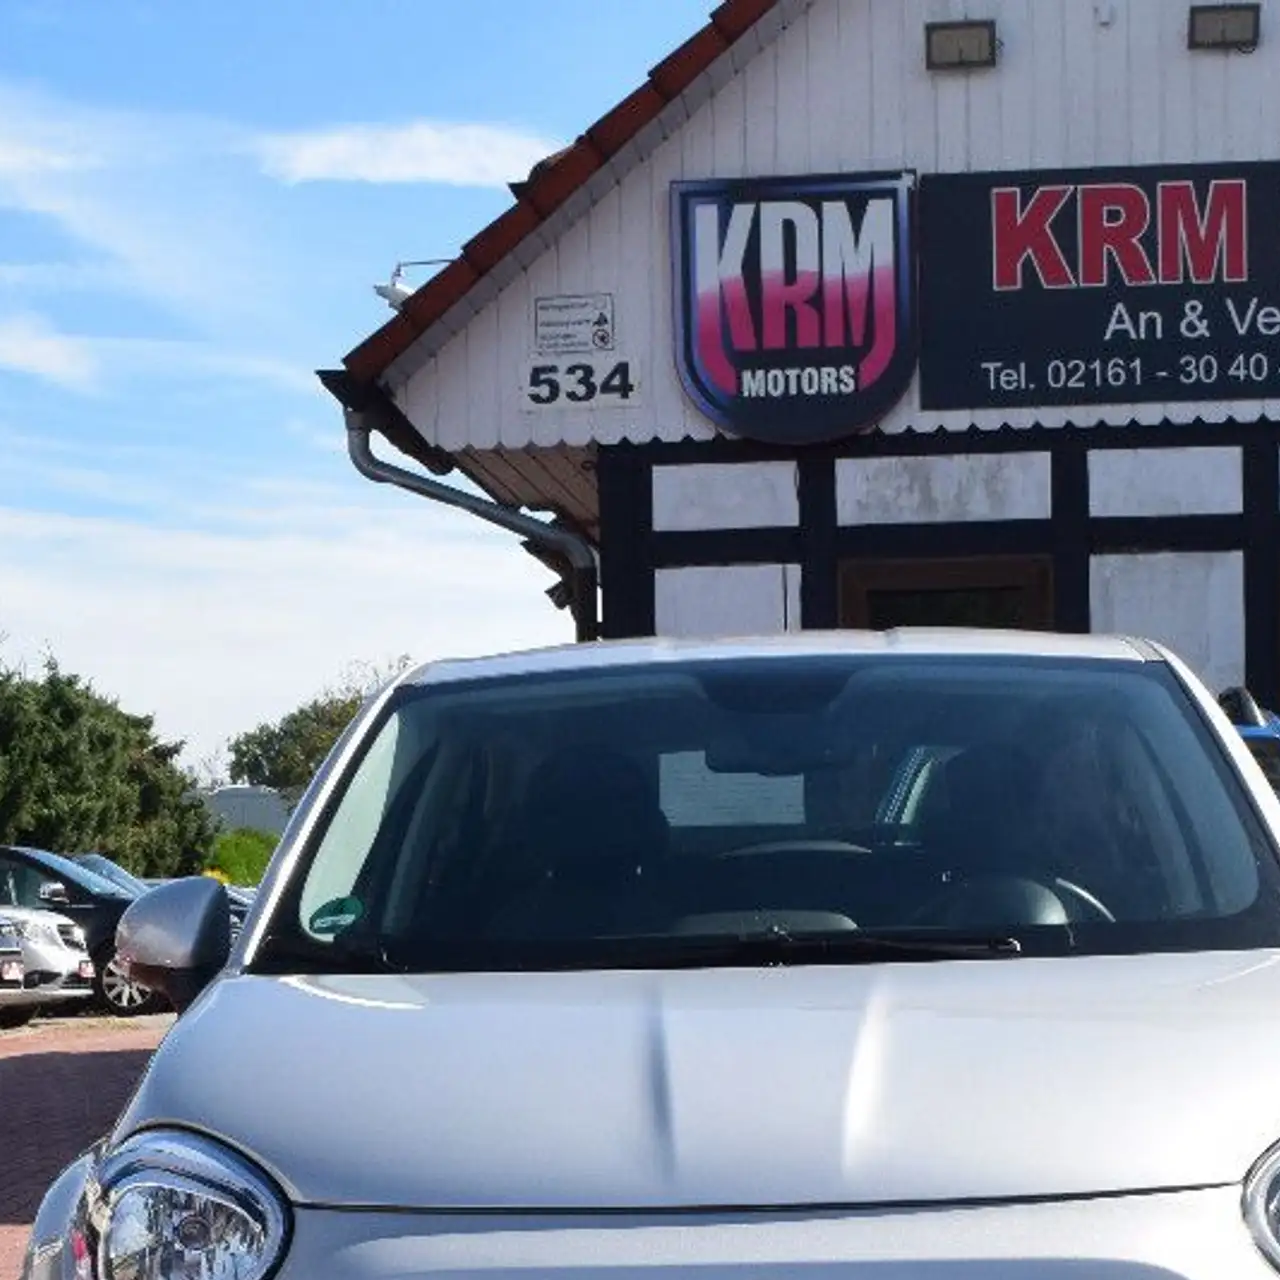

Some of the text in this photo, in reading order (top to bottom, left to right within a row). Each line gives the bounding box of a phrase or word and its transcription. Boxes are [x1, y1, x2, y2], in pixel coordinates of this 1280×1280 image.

[990, 178, 1248, 292] KRM
[694, 199, 896, 395] KRM
[1103, 302, 1163, 341] An
[1179, 300, 1210, 339] &
[527, 361, 635, 405] 534
[740, 364, 857, 399] MOTORS
[980, 361, 1036, 392] Tel.
[1047, 357, 1143, 389] 02161
[1178, 354, 1218, 384] 30
[1228, 353, 1268, 382] 40
